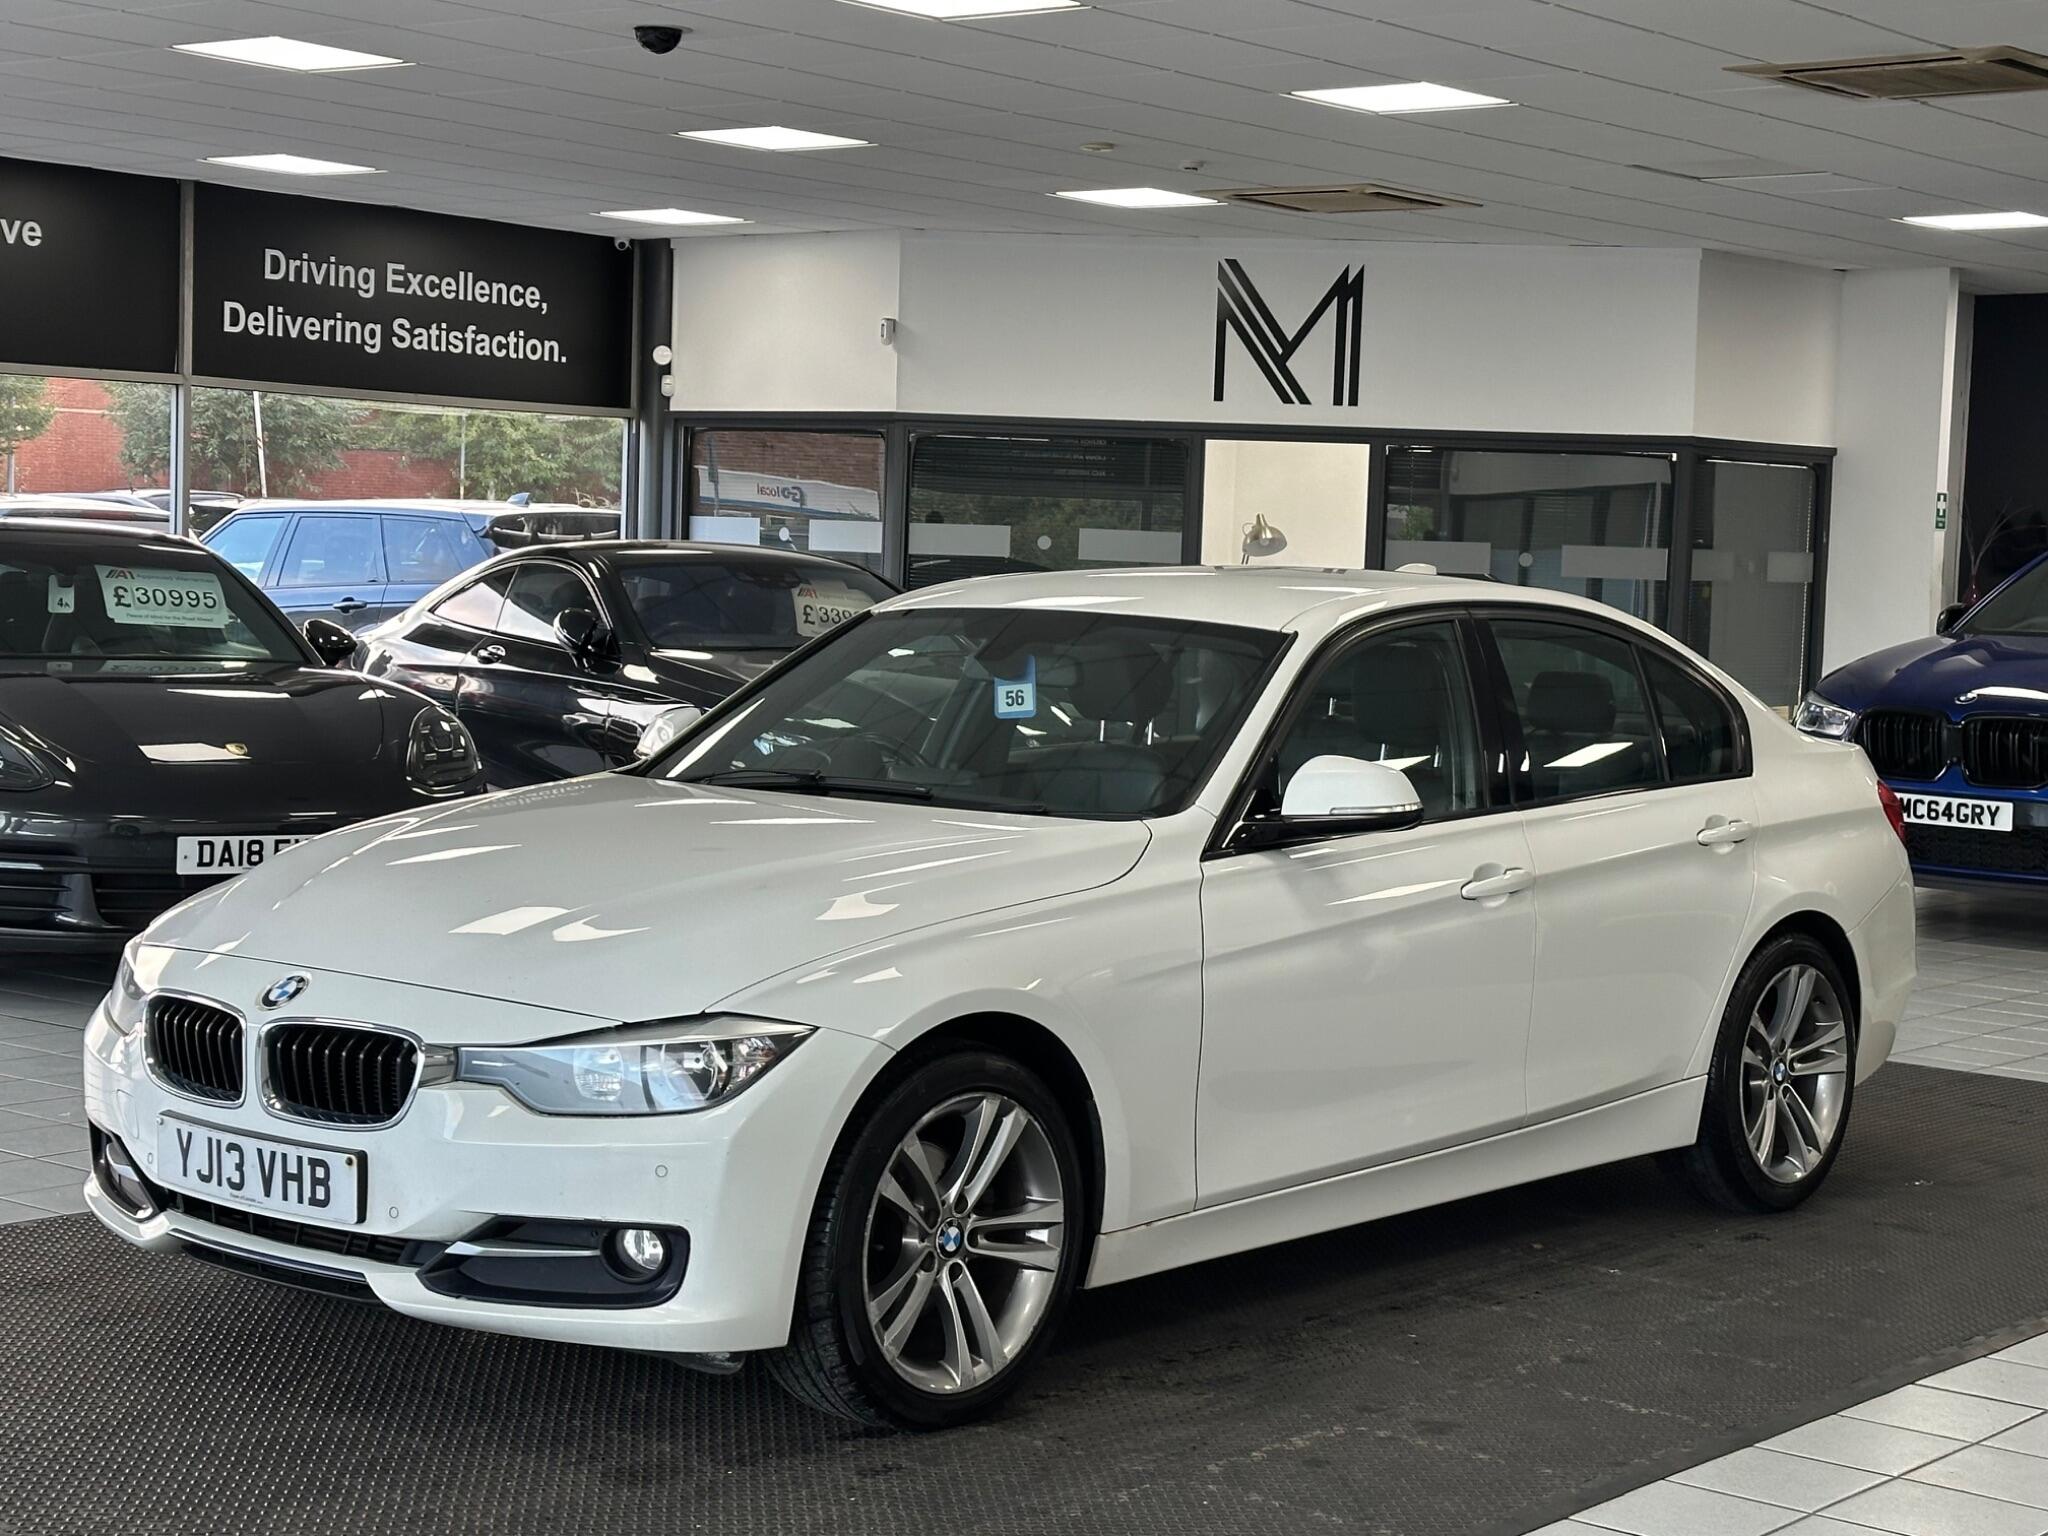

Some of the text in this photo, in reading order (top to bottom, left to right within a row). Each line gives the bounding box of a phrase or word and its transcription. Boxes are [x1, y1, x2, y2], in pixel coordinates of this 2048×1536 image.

[0, 218, 42, 247] ve
[264, 248, 548, 315] Driving Excellence,
[223, 300, 567, 363] Delivering Satisfaction.
[113, 585, 218, 609] £30995
[1005, 689, 1025, 707] 56
[1899, 797, 2000, 827] MC64GRY
[196, 839, 264, 868] DA18
[176, 1127, 331, 1209] YJ13 VHB
